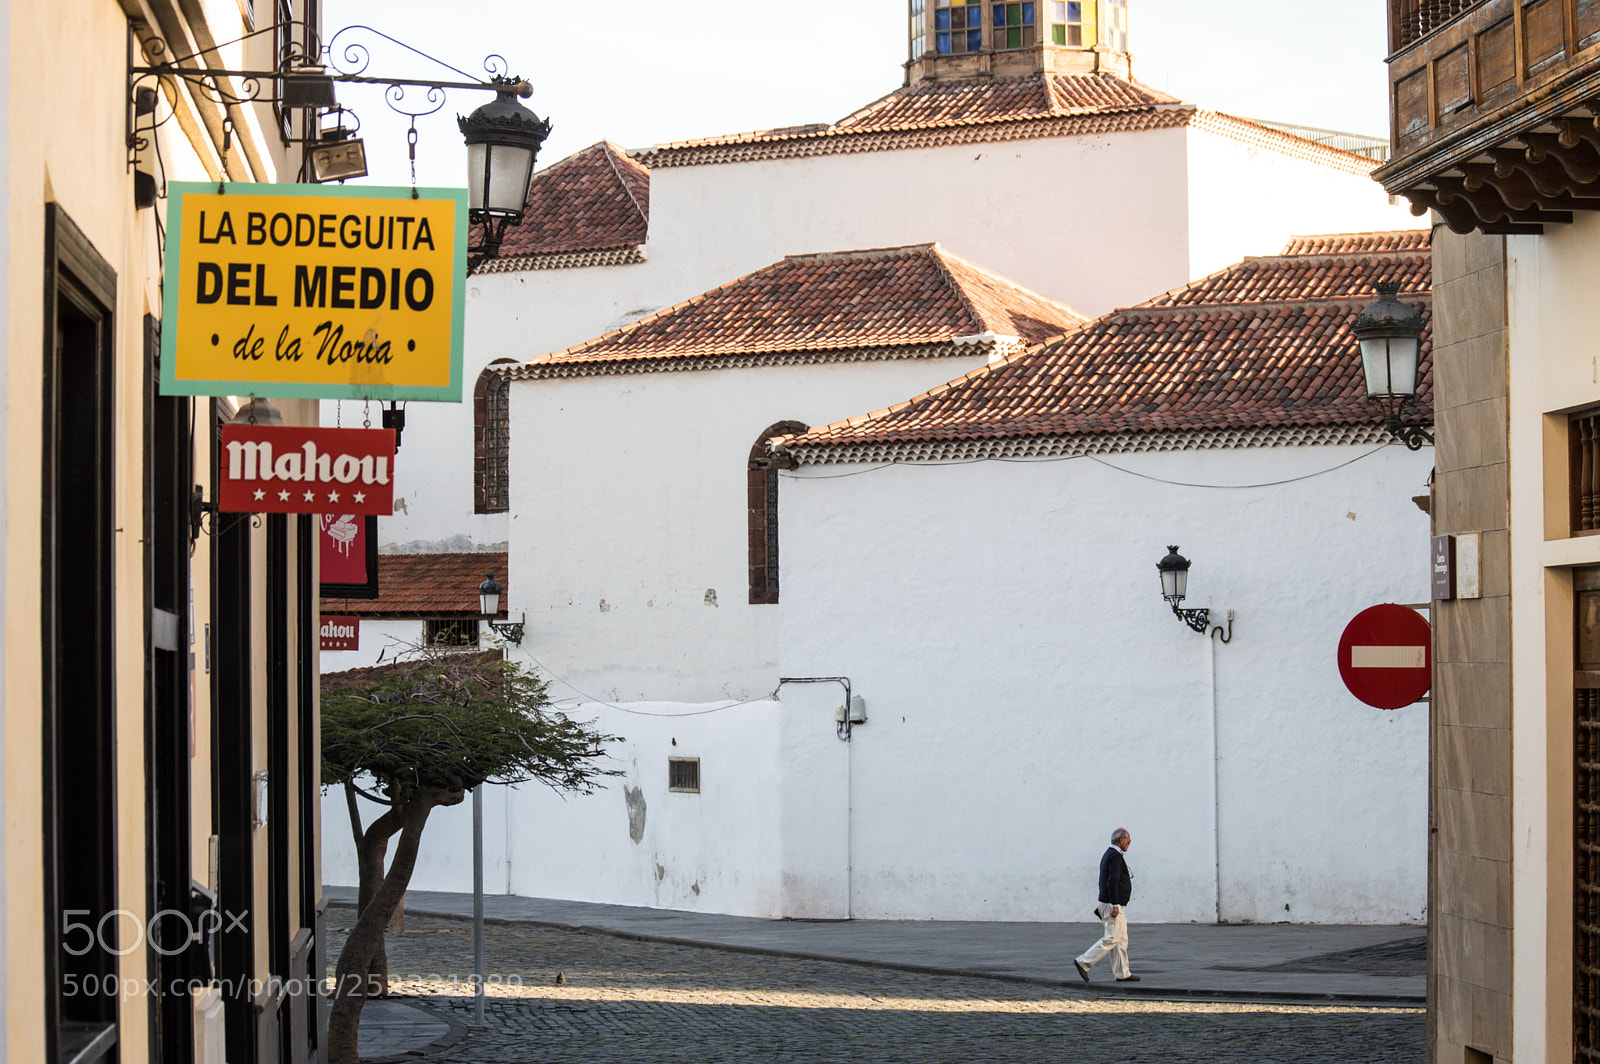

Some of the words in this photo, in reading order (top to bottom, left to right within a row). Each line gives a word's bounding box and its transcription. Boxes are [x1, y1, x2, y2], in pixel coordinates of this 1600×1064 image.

[199, 210, 237, 245] LA
[247, 211, 435, 251] BODEGUITA
[196, 261, 278, 307] DEL
[294, 264, 435, 312] MEDIO
[233, 323, 264, 361] de
[275, 324, 303, 362] la
[313, 320, 394, 365] Noria
[320, 620, 355, 638] ahou
